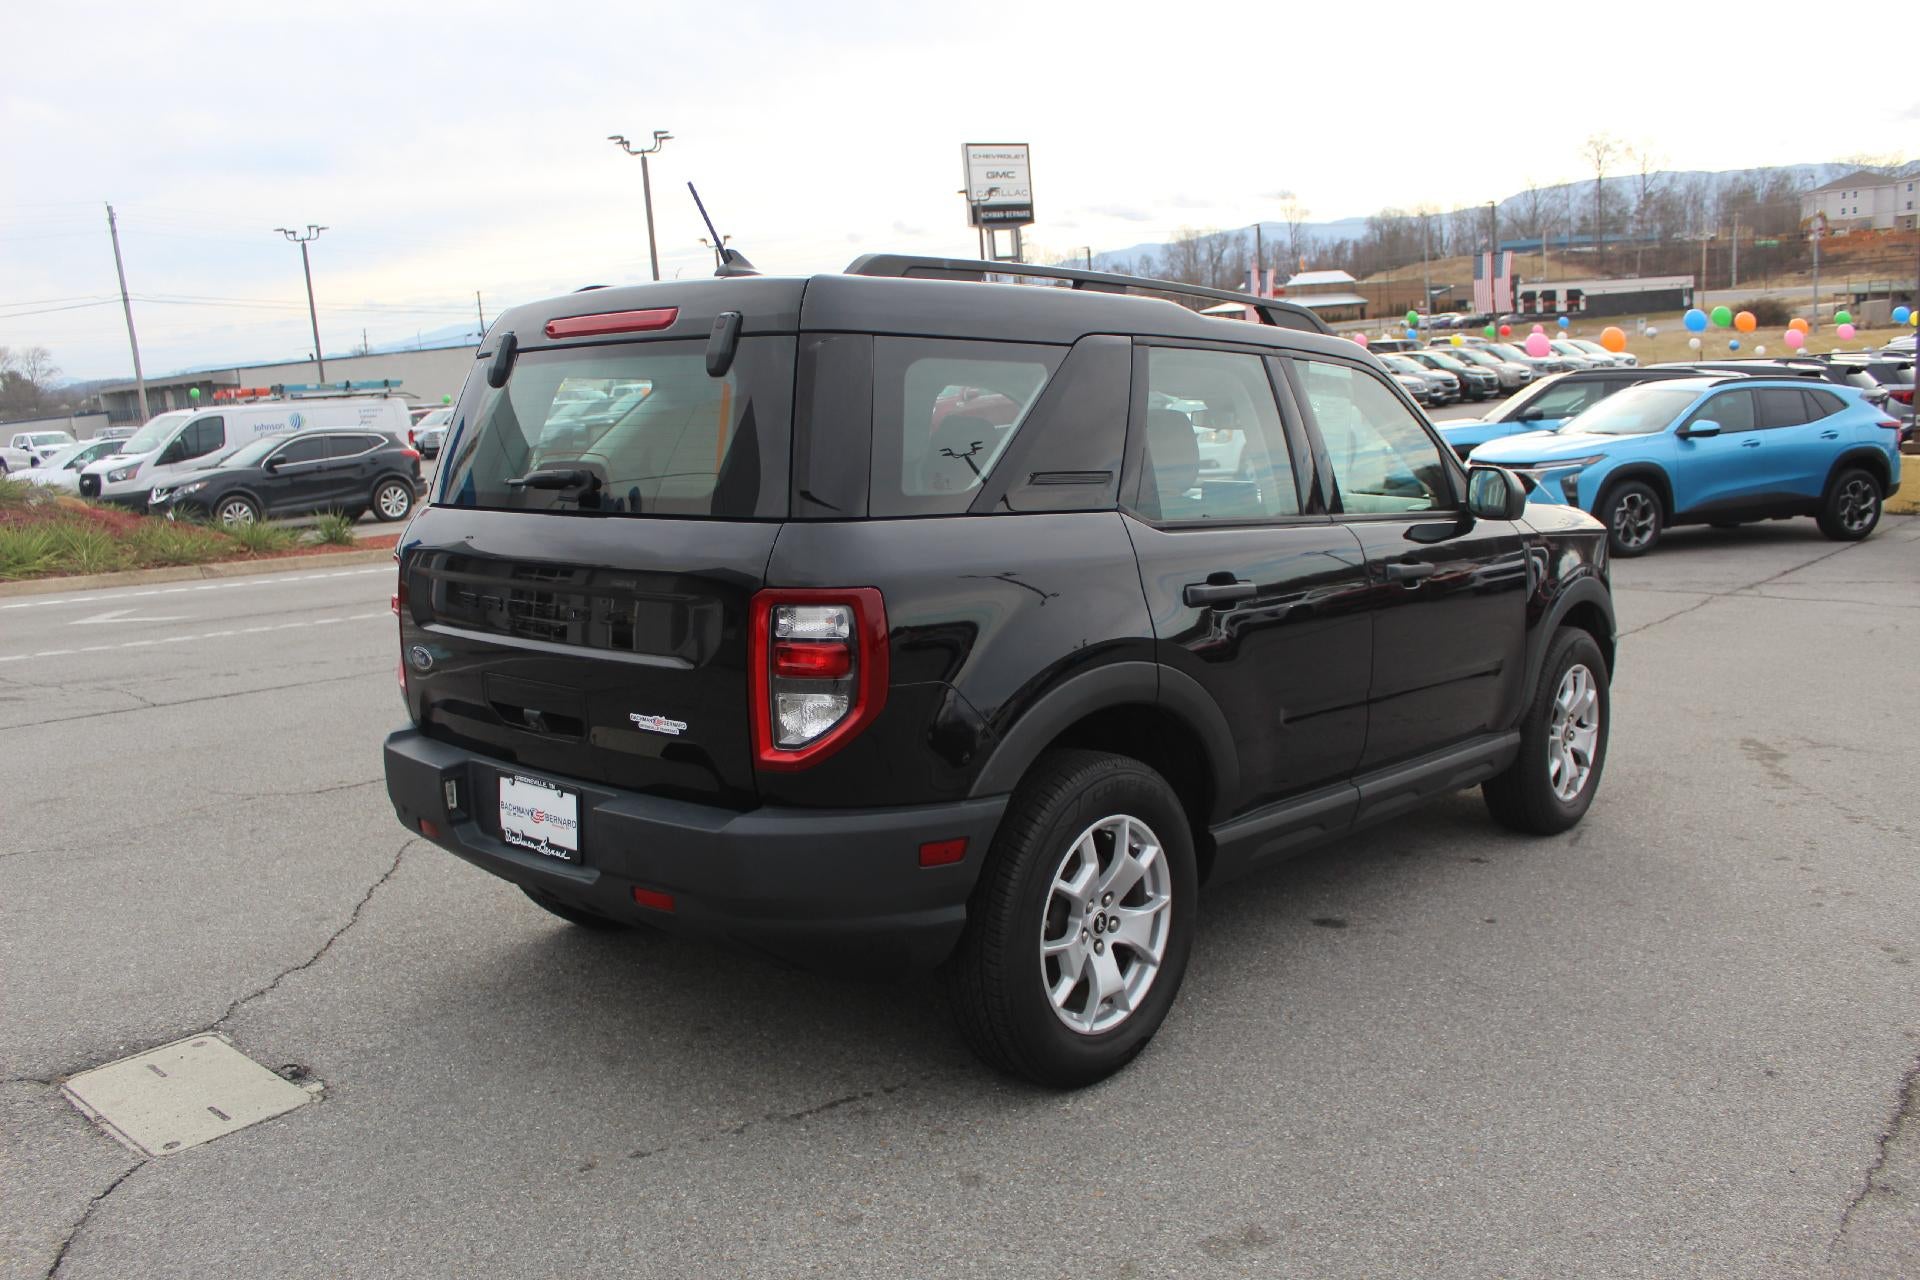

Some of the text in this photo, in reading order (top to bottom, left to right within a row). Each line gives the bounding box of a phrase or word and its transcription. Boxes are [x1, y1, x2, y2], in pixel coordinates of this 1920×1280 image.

[986, 170, 1016, 179] GMC
[253, 423, 285, 432] Johnson
[500, 800, 530, 816] BACHMAN
[544, 813, 577, 829] BERNARD
